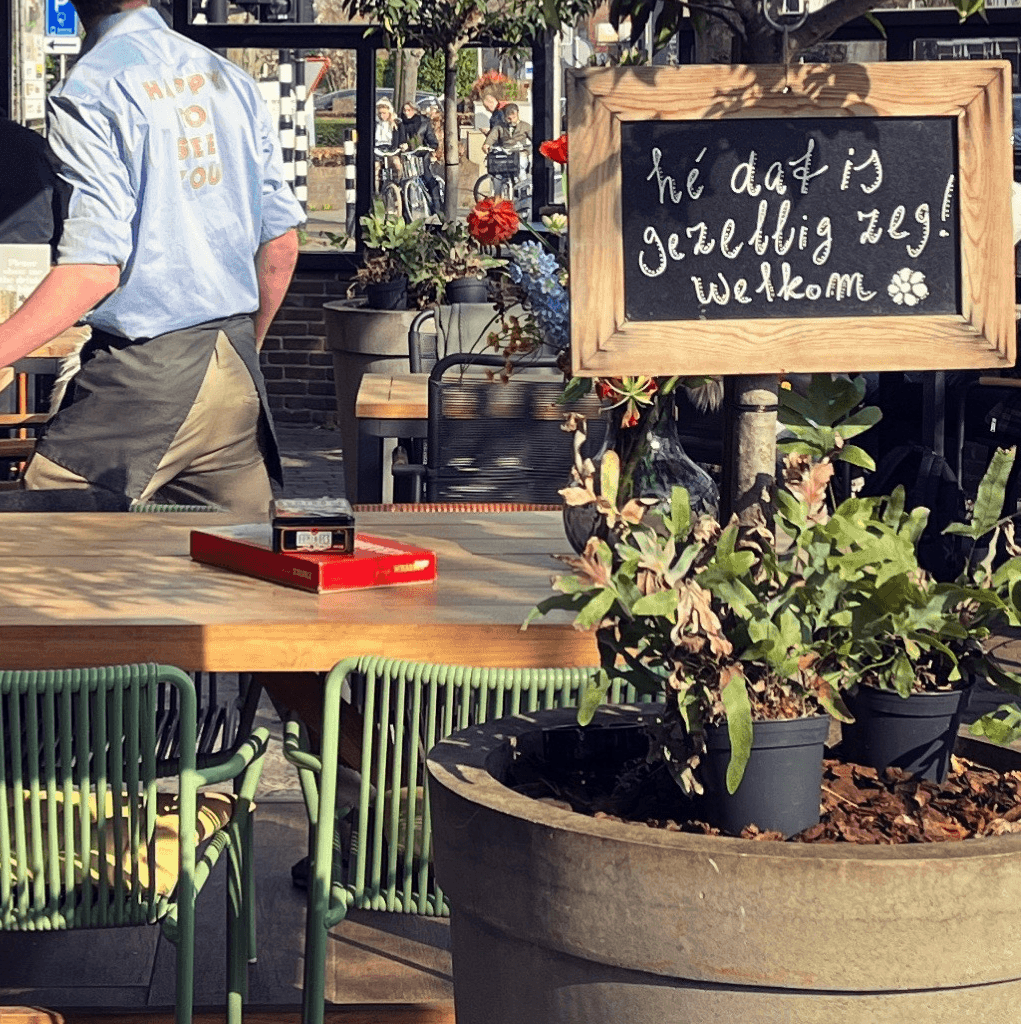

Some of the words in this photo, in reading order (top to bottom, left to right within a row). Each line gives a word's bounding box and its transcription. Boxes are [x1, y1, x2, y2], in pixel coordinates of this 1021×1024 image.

[647, 147, 707, 204] hé
[730, 138, 828, 197] dat
[840, 147, 883, 193] is
[638, 199, 832, 277] gezellig
[857, 174, 955, 258] zeg!
